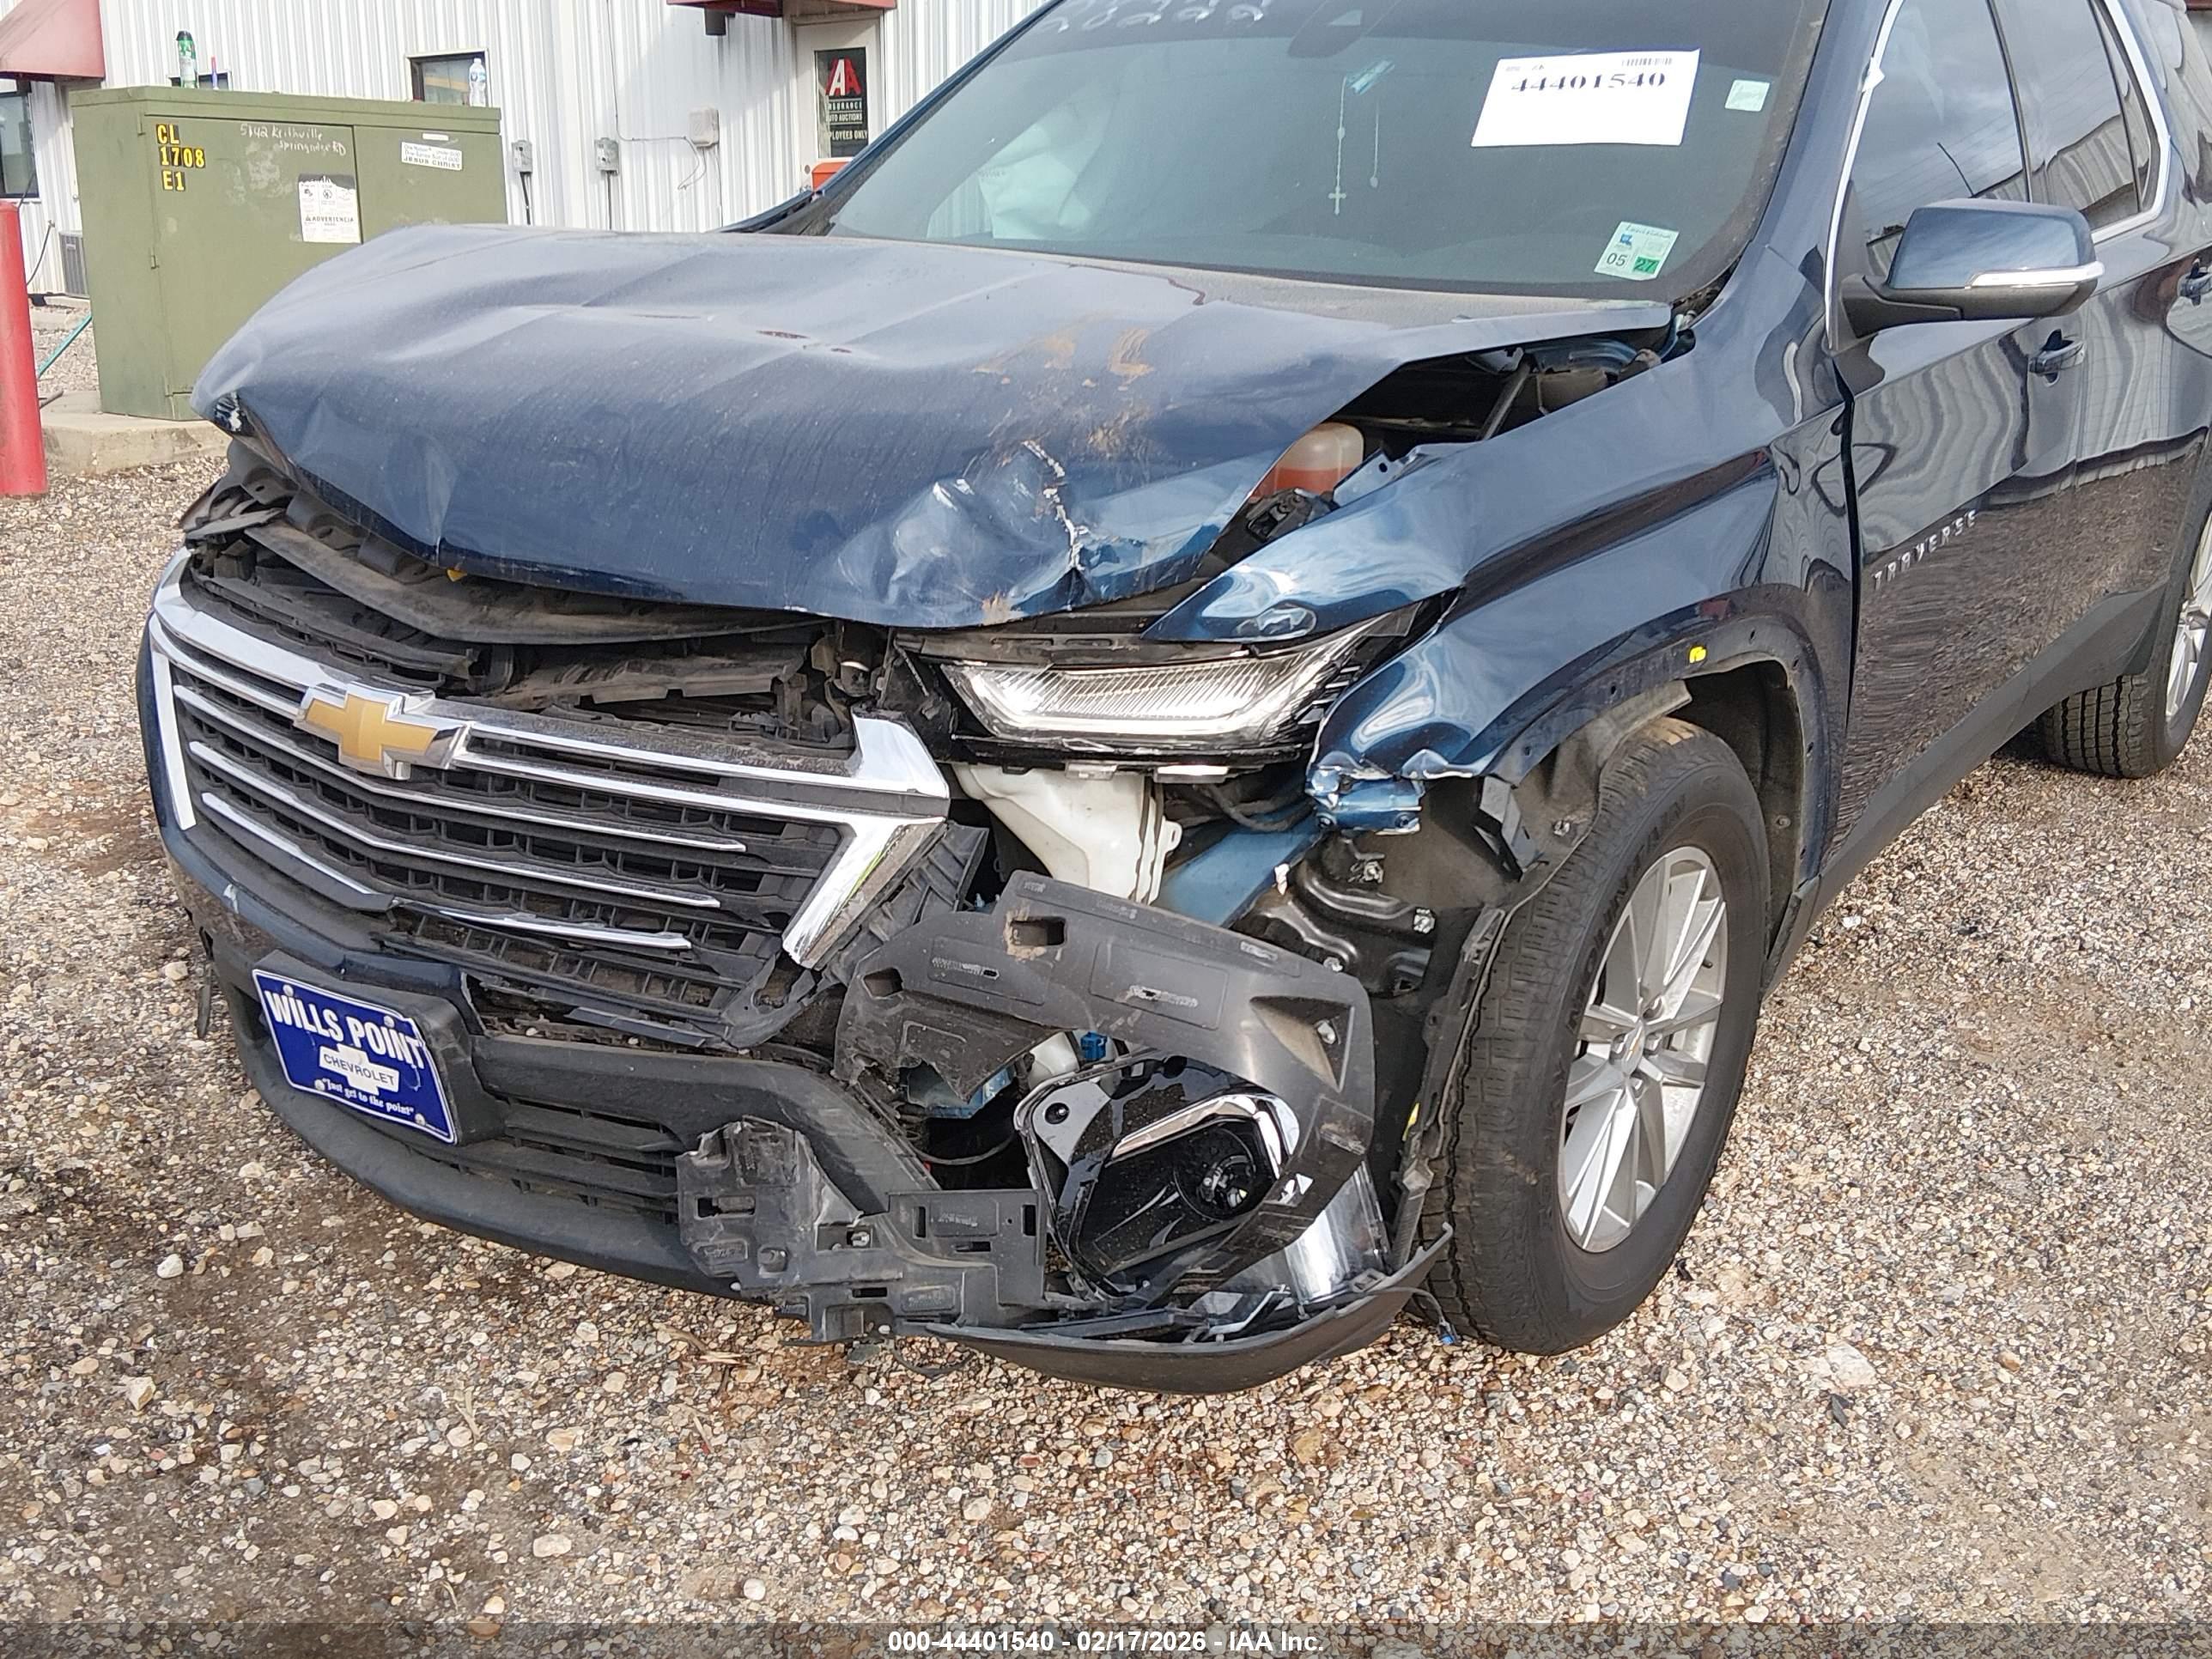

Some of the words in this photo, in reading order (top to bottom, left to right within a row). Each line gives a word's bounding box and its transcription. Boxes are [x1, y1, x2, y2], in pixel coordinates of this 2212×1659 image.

[1511, 73, 1665, 92] 44401540
[157, 124, 179, 143] CL
[854, 130, 868, 140] ONLY
[160, 146, 205, 168] 1708
[404, 155, 429, 165] JESUS
[432, 160, 460, 169] CHRIST
[162, 170, 185, 191] E1
[1607, 252, 1627, 267] 05
[1633, 257, 1657, 272] 27
[1872, 509, 1976, 591] TRAVERSE
[264, 990, 344, 1042] WILLS
[345, 1016, 425, 1070] POINT
[323, 1053, 397, 1085] CHEVROLET
[358, 1091, 368, 1103] to
[369, 1096, 384, 1108] the
